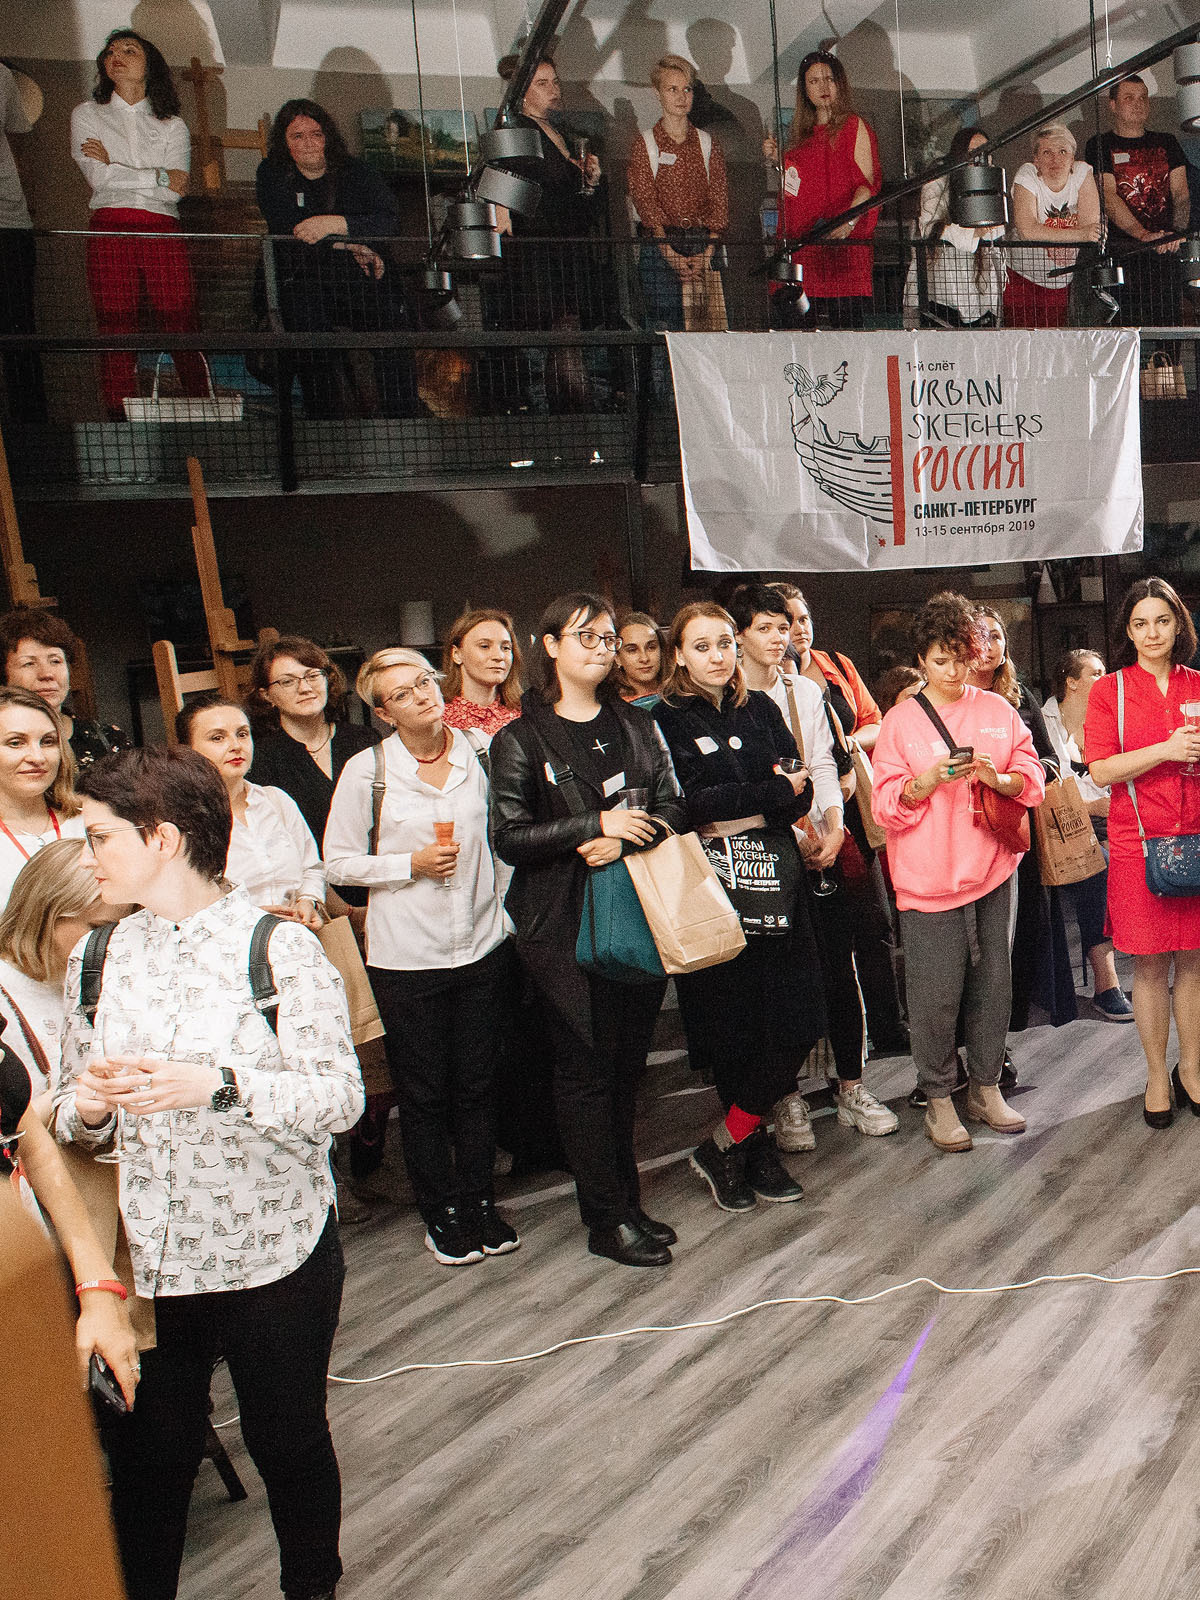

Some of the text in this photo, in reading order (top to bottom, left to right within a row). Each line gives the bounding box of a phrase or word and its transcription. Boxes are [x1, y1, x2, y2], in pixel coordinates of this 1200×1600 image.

[905, 360, 956, 372] 1-й слёт
[910, 374, 1003, 408] URBAN
[907, 413, 1043, 441] SKETCHERS
[912, 442, 1025, 493] РОССИЯ
[913, 498, 1038, 519] САНКТ-ПЕТЕРБУРГ
[915, 520, 1036, 537] 13-15 сентября 2019
[732, 840, 765, 851] URBAN
[734, 860, 776, 878] РОССИЯ
